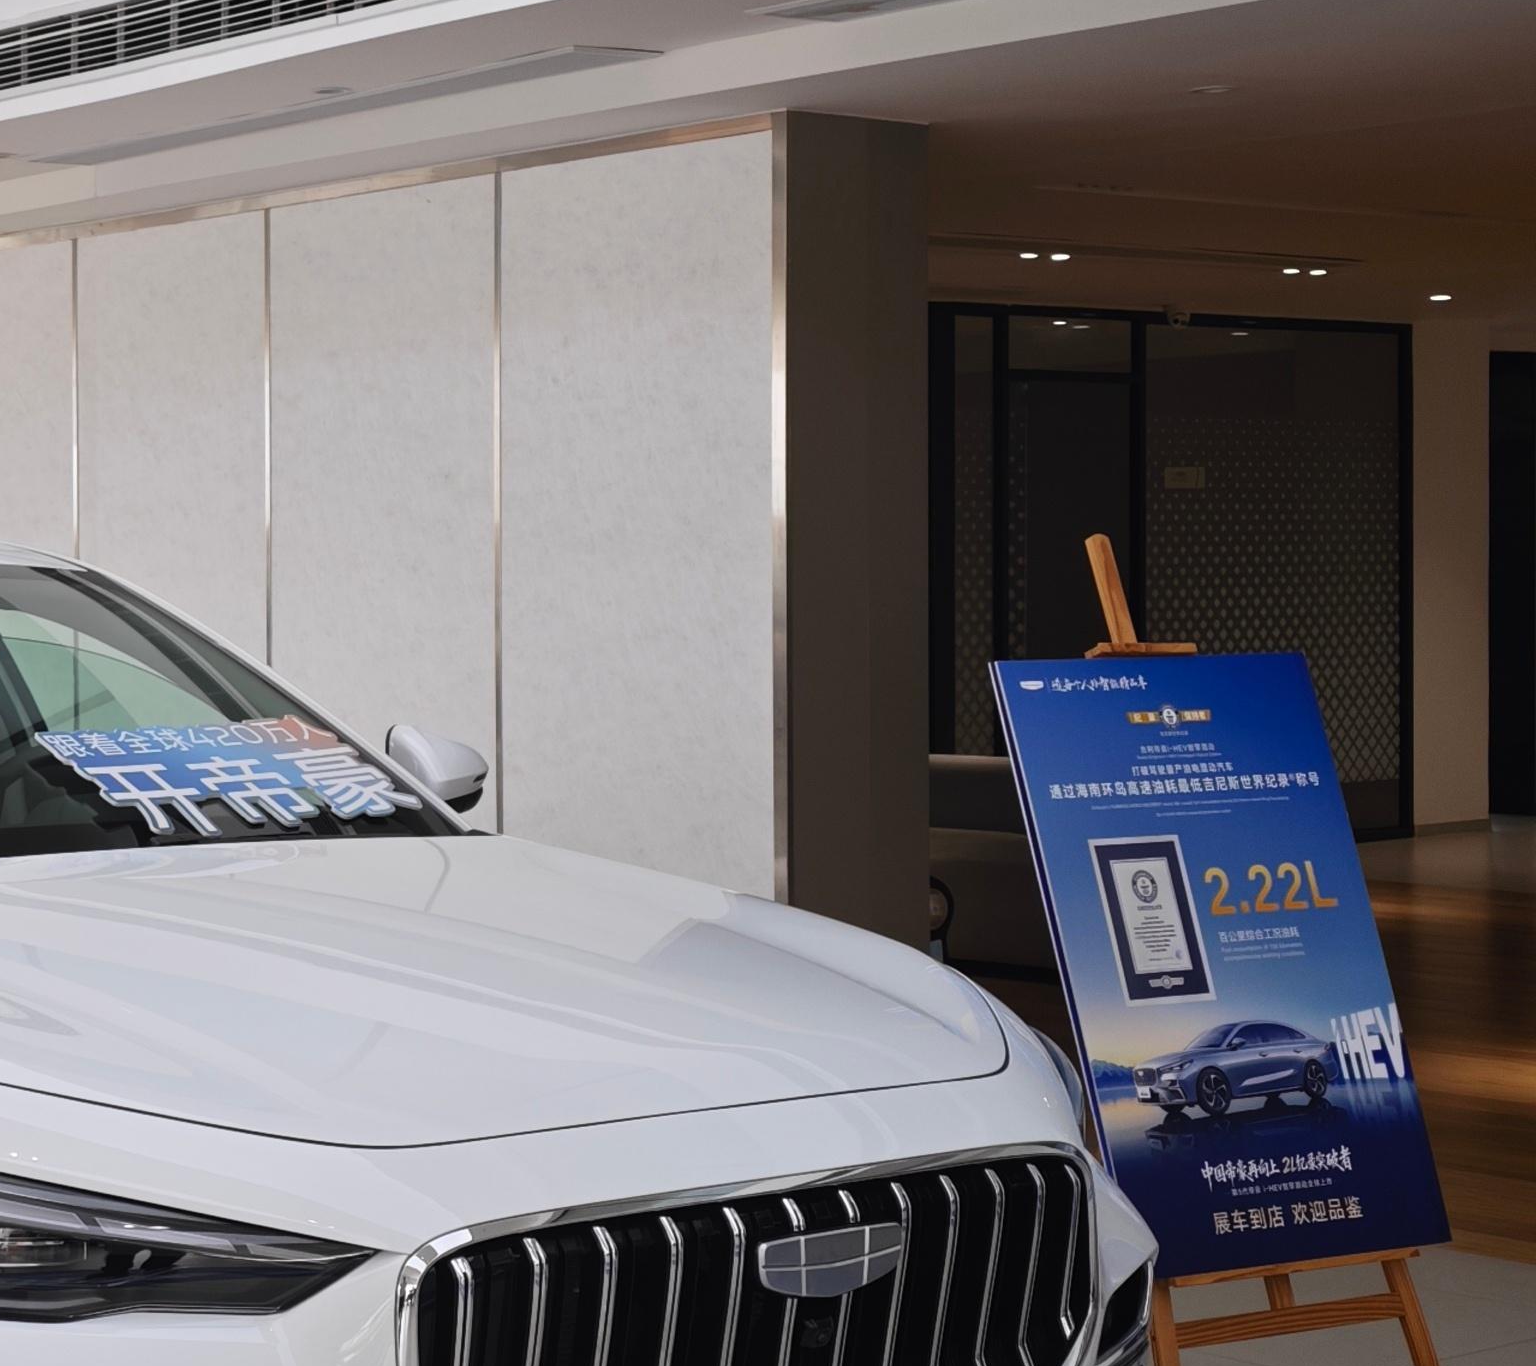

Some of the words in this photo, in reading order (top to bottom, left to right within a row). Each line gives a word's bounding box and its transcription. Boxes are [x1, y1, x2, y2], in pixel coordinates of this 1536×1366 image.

[41, 715, 335, 759] 跟着全球420万人
[84, 745, 424, 835] 开帝豪
[1204, 859, 1339, 917] 2.22L
[1213, 1205, 1285, 1236] 展车到店
[1291, 1196, 1364, 1226] 欢迎品鉴
